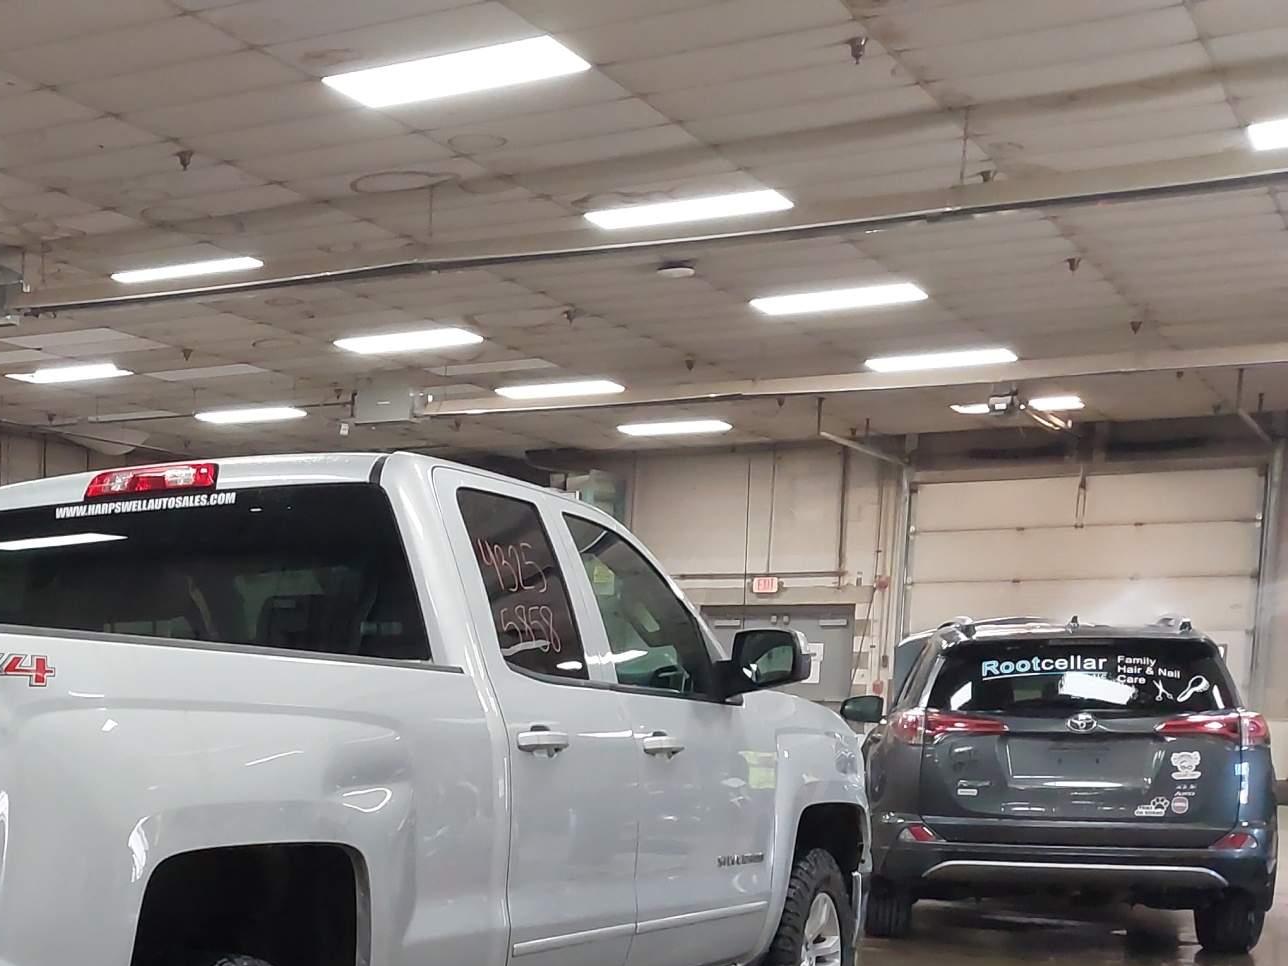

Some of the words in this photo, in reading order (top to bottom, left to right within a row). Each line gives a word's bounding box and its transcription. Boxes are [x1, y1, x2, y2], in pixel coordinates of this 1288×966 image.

[55, 492, 236, 519] WWW.HARPSWELLAUTOSALES.COM
[477, 538, 547, 592] 4325
[500, 604, 561, 653] 5858
[981, 655, 1108, 677] Rootcellar
[1117, 655, 1157, 667] Family
[1117, 664, 1143, 675] Hair
[1145, 666, 1155, 676] &
[1158, 667, 1181, 679] Nail
[1117, 674, 1146, 685] Care
